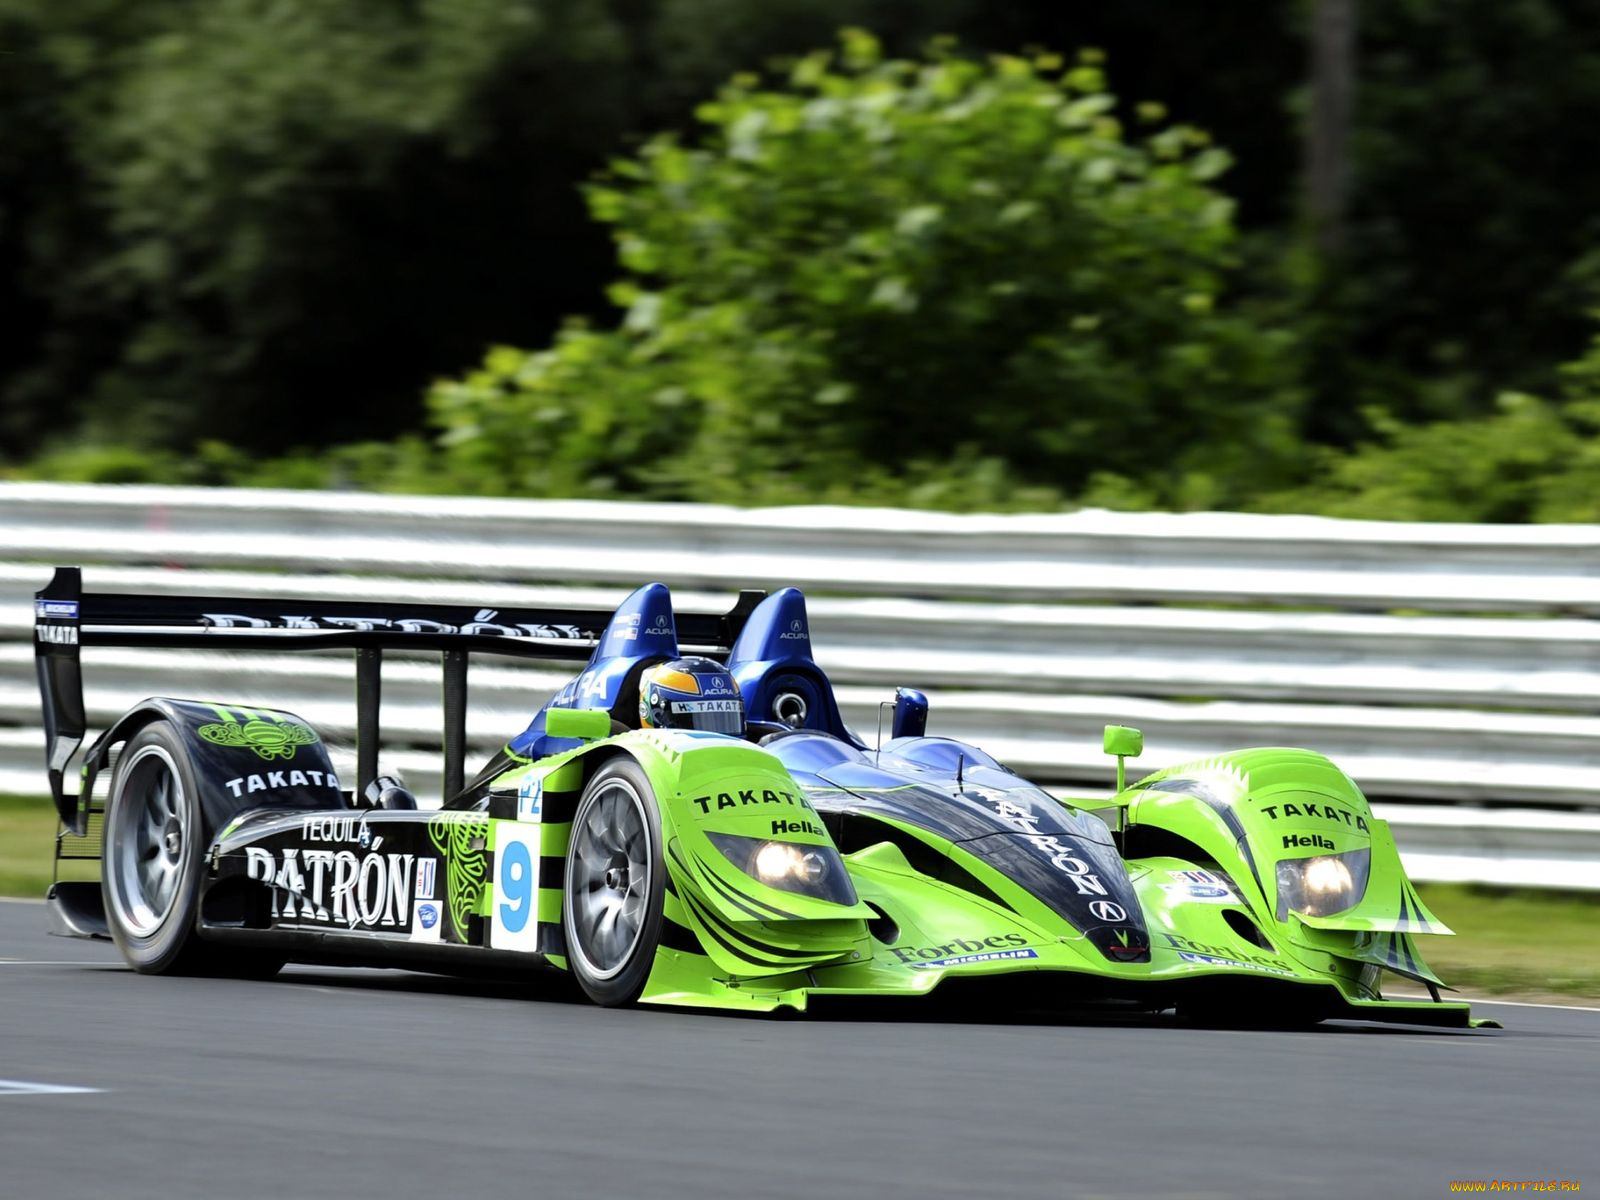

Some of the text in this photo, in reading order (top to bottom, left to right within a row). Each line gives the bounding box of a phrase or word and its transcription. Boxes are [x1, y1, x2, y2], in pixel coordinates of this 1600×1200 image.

[704, 688, 733, 696] ACURA
[225, 770, 338, 798] TAKATA
[302, 817, 371, 842] TEQUILA
[771, 819, 825, 835] Hella
[1261, 803, 1370, 834] TAKATA
[1283, 834, 1336, 850] Hella
[245, 836, 415, 926] PATRÓN
[500, 841, 532, 933] 9
[892, 933, 1028, 964] Forbes
[943, 950, 1029, 966] MICHELIN
[1160, 932, 1293, 972] Forbes
